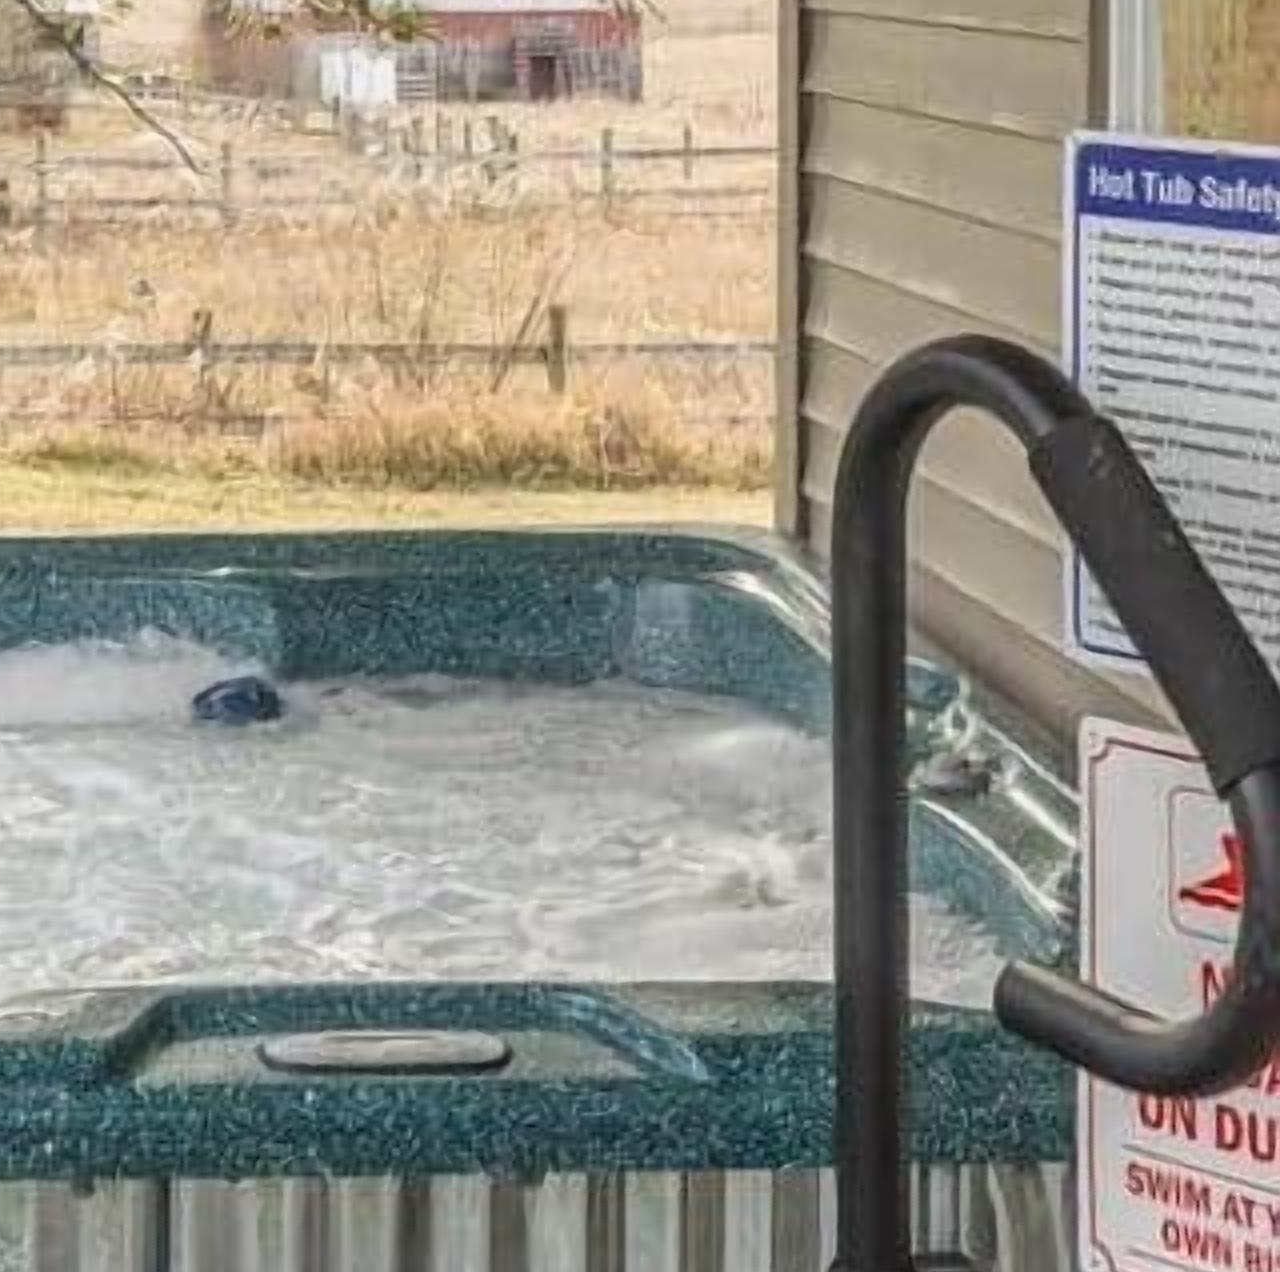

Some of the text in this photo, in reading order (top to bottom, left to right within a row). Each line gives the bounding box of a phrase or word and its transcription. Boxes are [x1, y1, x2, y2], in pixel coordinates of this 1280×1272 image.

[1089, 165, 1134, 201] Hot
[1141, 169, 1196, 205] Tub
[1138, 1090, 1197, 1141] ON
[1125, 1162, 1212, 1216] SWIM
[1223, 1192, 1261, 1228] AT
[1161, 1218, 1233, 1267] OWN
